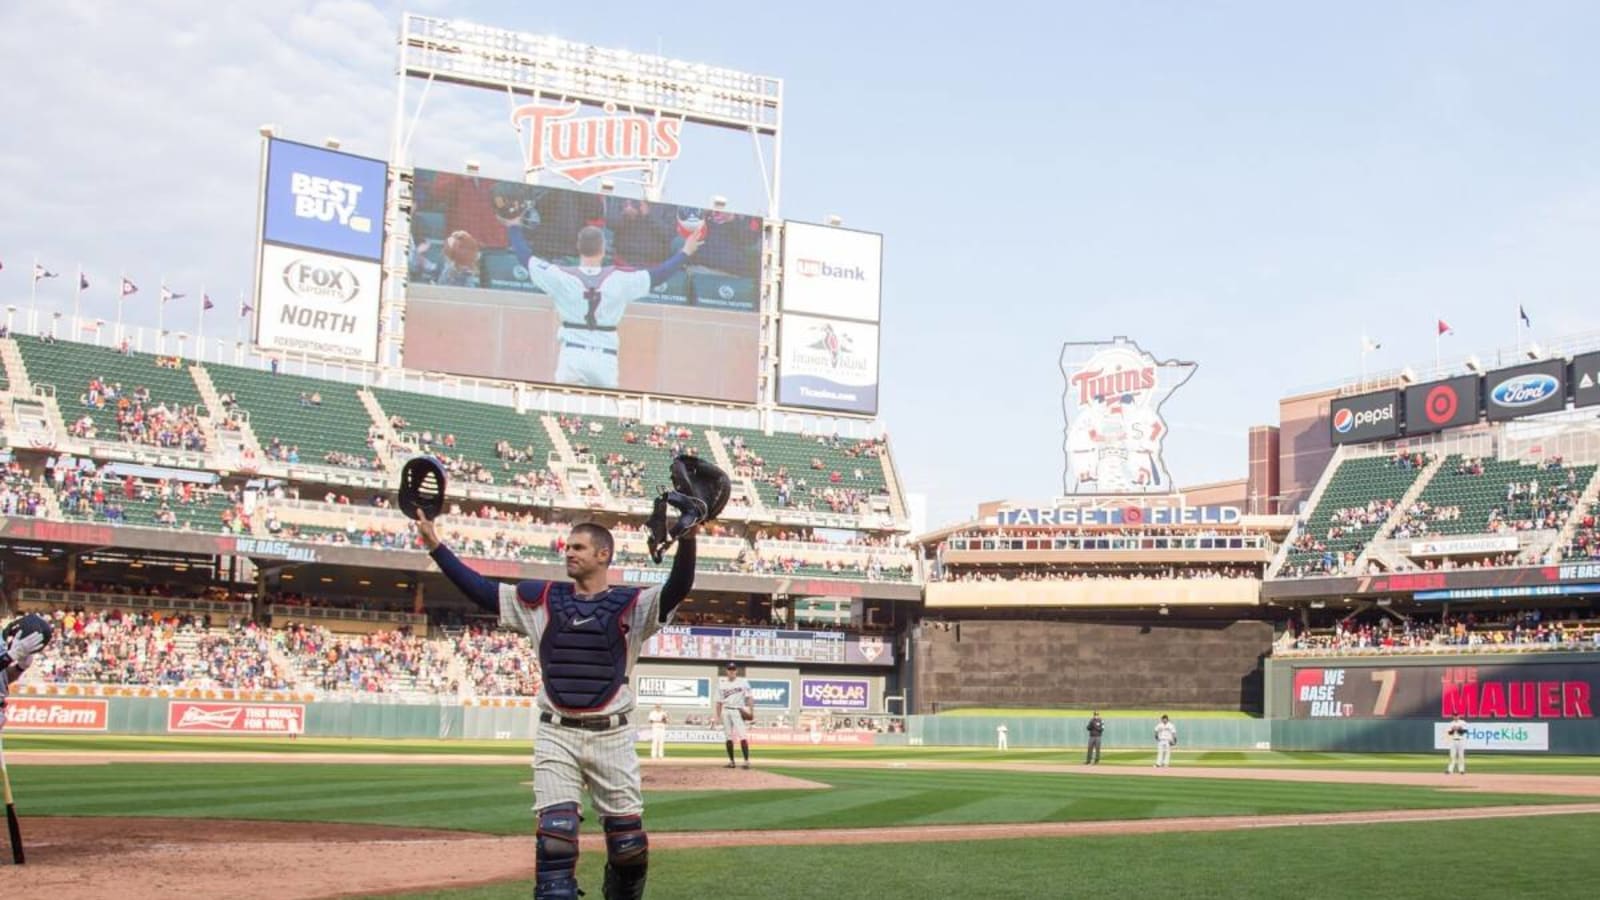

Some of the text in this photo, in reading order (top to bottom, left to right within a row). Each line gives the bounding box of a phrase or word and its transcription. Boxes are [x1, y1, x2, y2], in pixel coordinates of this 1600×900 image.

[512, 101, 680, 169] Twins
[291, 172, 363, 207] BEST
[295, 194, 358, 225] BUY
[300, 264, 343, 290] FOX
[797, 258, 865, 282] bank
[298, 284, 345, 299] SPORTS
[280, 303, 357, 334] NORTH
[1071, 364, 1155, 405] Twins
[1503, 381, 1545, 402] Ford
[1355, 403, 1394, 429] pepsi
[997, 506, 1242, 525] TARGET FIELD
[236, 538, 289, 555] WE BASE
[286, 547, 316, 562] BALL
[624, 569, 640, 582] WE
[1560, 566, 1577, 579] WE
[1357, 577, 1372, 593] 7
[662, 626, 691, 635] DRAKE
[1323, 669, 1345, 685] WE
[1441, 666, 1478, 682] JOE
[823, 685, 865, 699] SOLAR
[1300, 685, 1336, 701] BASE
[1371, 670, 1397, 716] 7
[1441, 681, 1595, 718] MAUER
[48, 705, 96, 724] Farm
[1311, 701, 1343, 717] BALL
[244, 718, 263, 729] FOR
[1466, 727, 1529, 744] HopeKids
